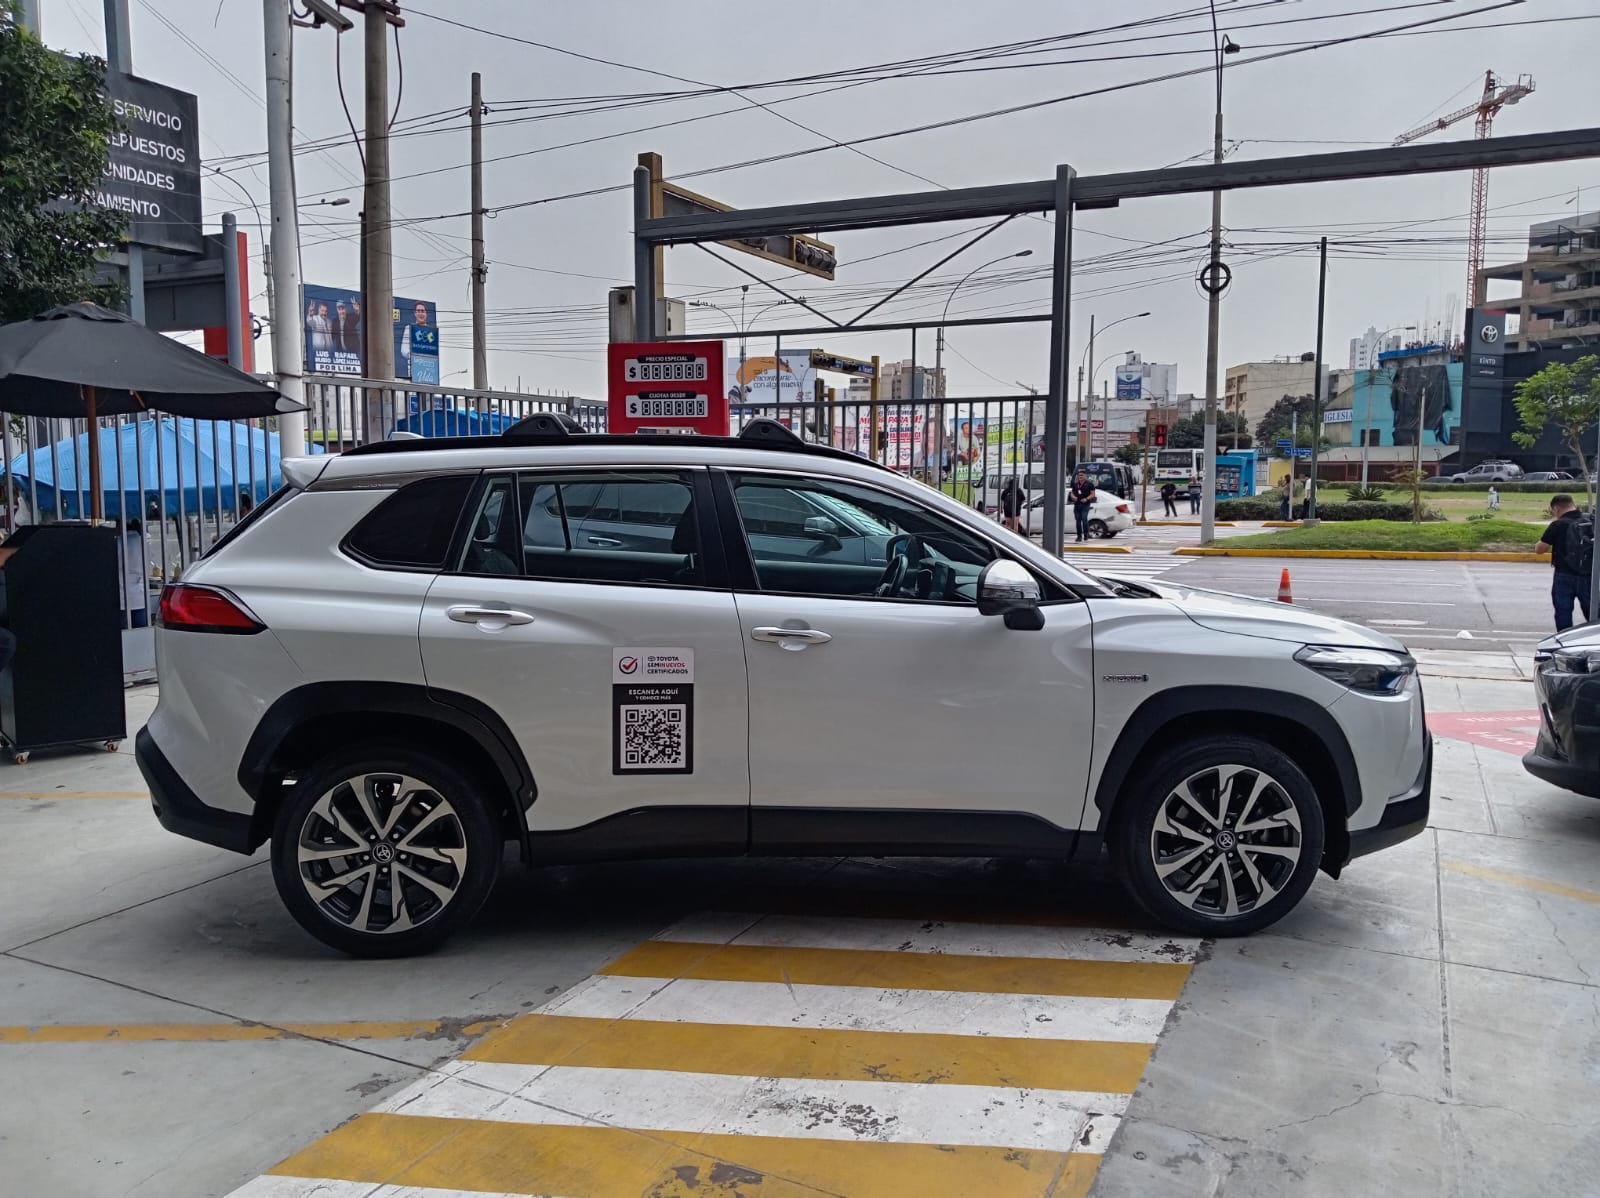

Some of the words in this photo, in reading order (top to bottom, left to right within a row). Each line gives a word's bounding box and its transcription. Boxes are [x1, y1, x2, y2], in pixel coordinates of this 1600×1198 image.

[113, 98, 182, 132] SERVICIO
[334, 351, 358, 359] RAFAEL
[661, 687, 679, 695] AQUÍ
